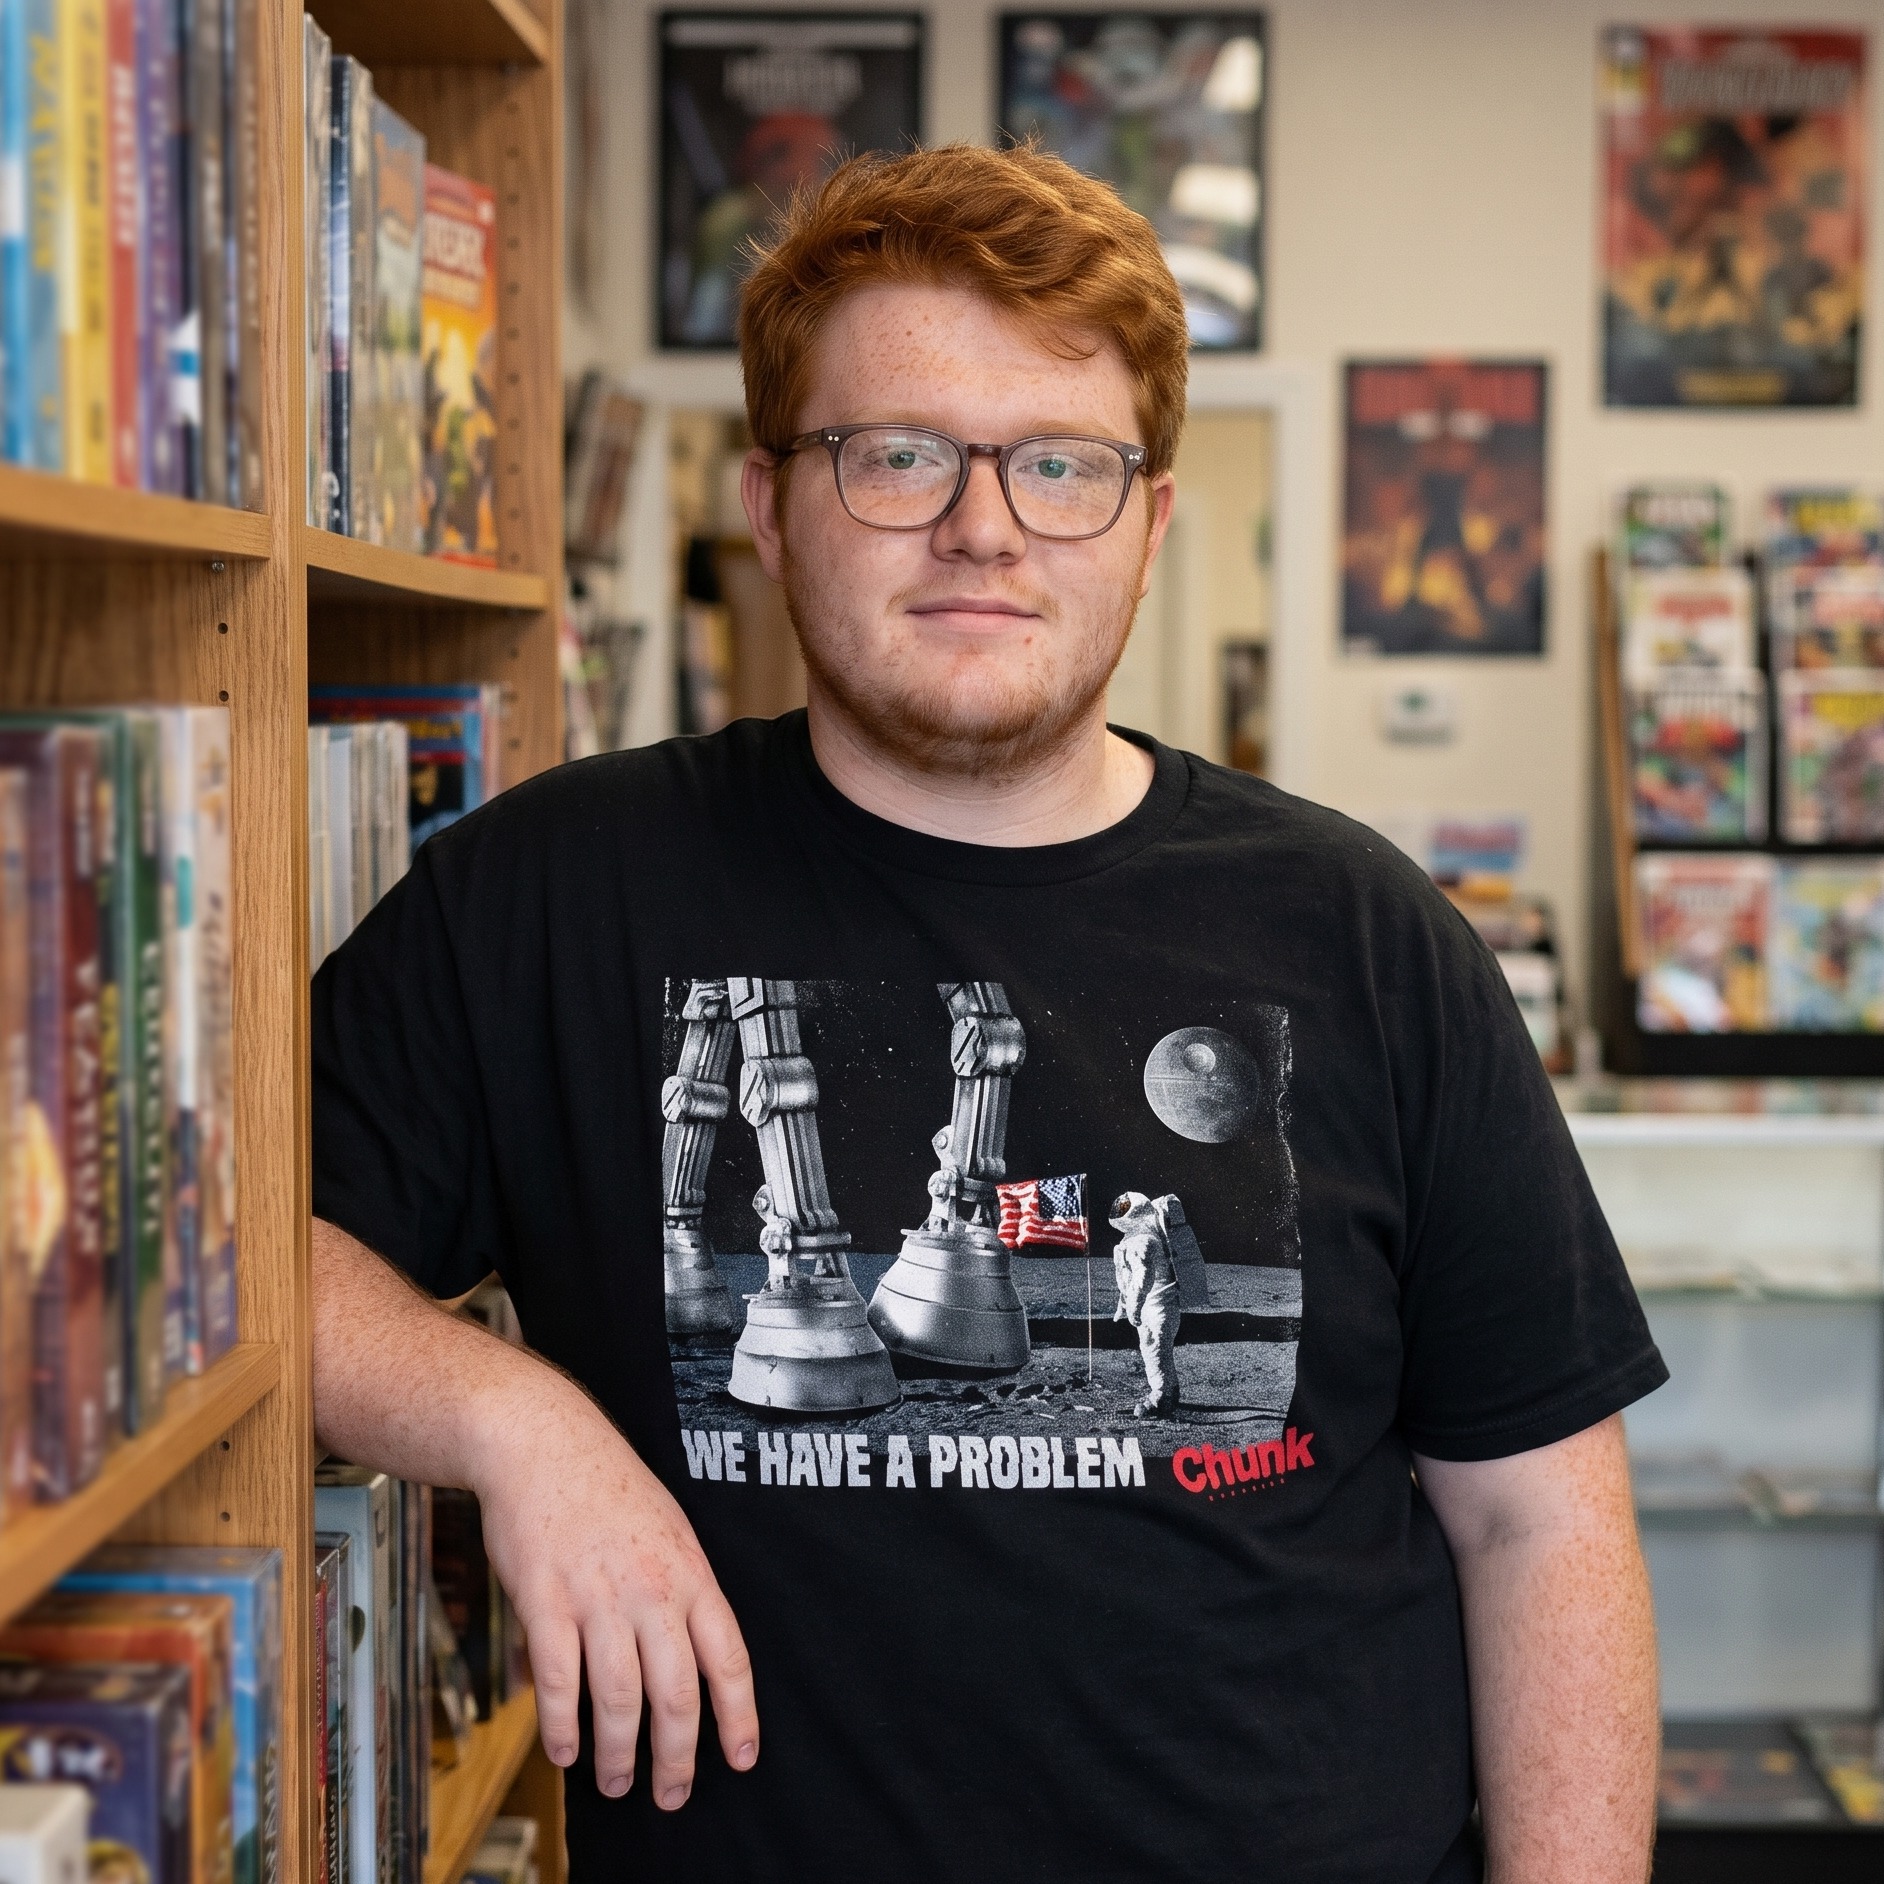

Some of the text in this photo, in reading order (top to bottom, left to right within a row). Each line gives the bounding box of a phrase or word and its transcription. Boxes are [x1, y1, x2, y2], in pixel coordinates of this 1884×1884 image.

[681, 1429, 746, 1482] WE
[758, 1432, 871, 1487] HAVE
[886, 1434, 917, 1488] A
[928, 1434, 1146, 1489] PROBLEM
[1172, 1426, 1315, 1493] Chunk
